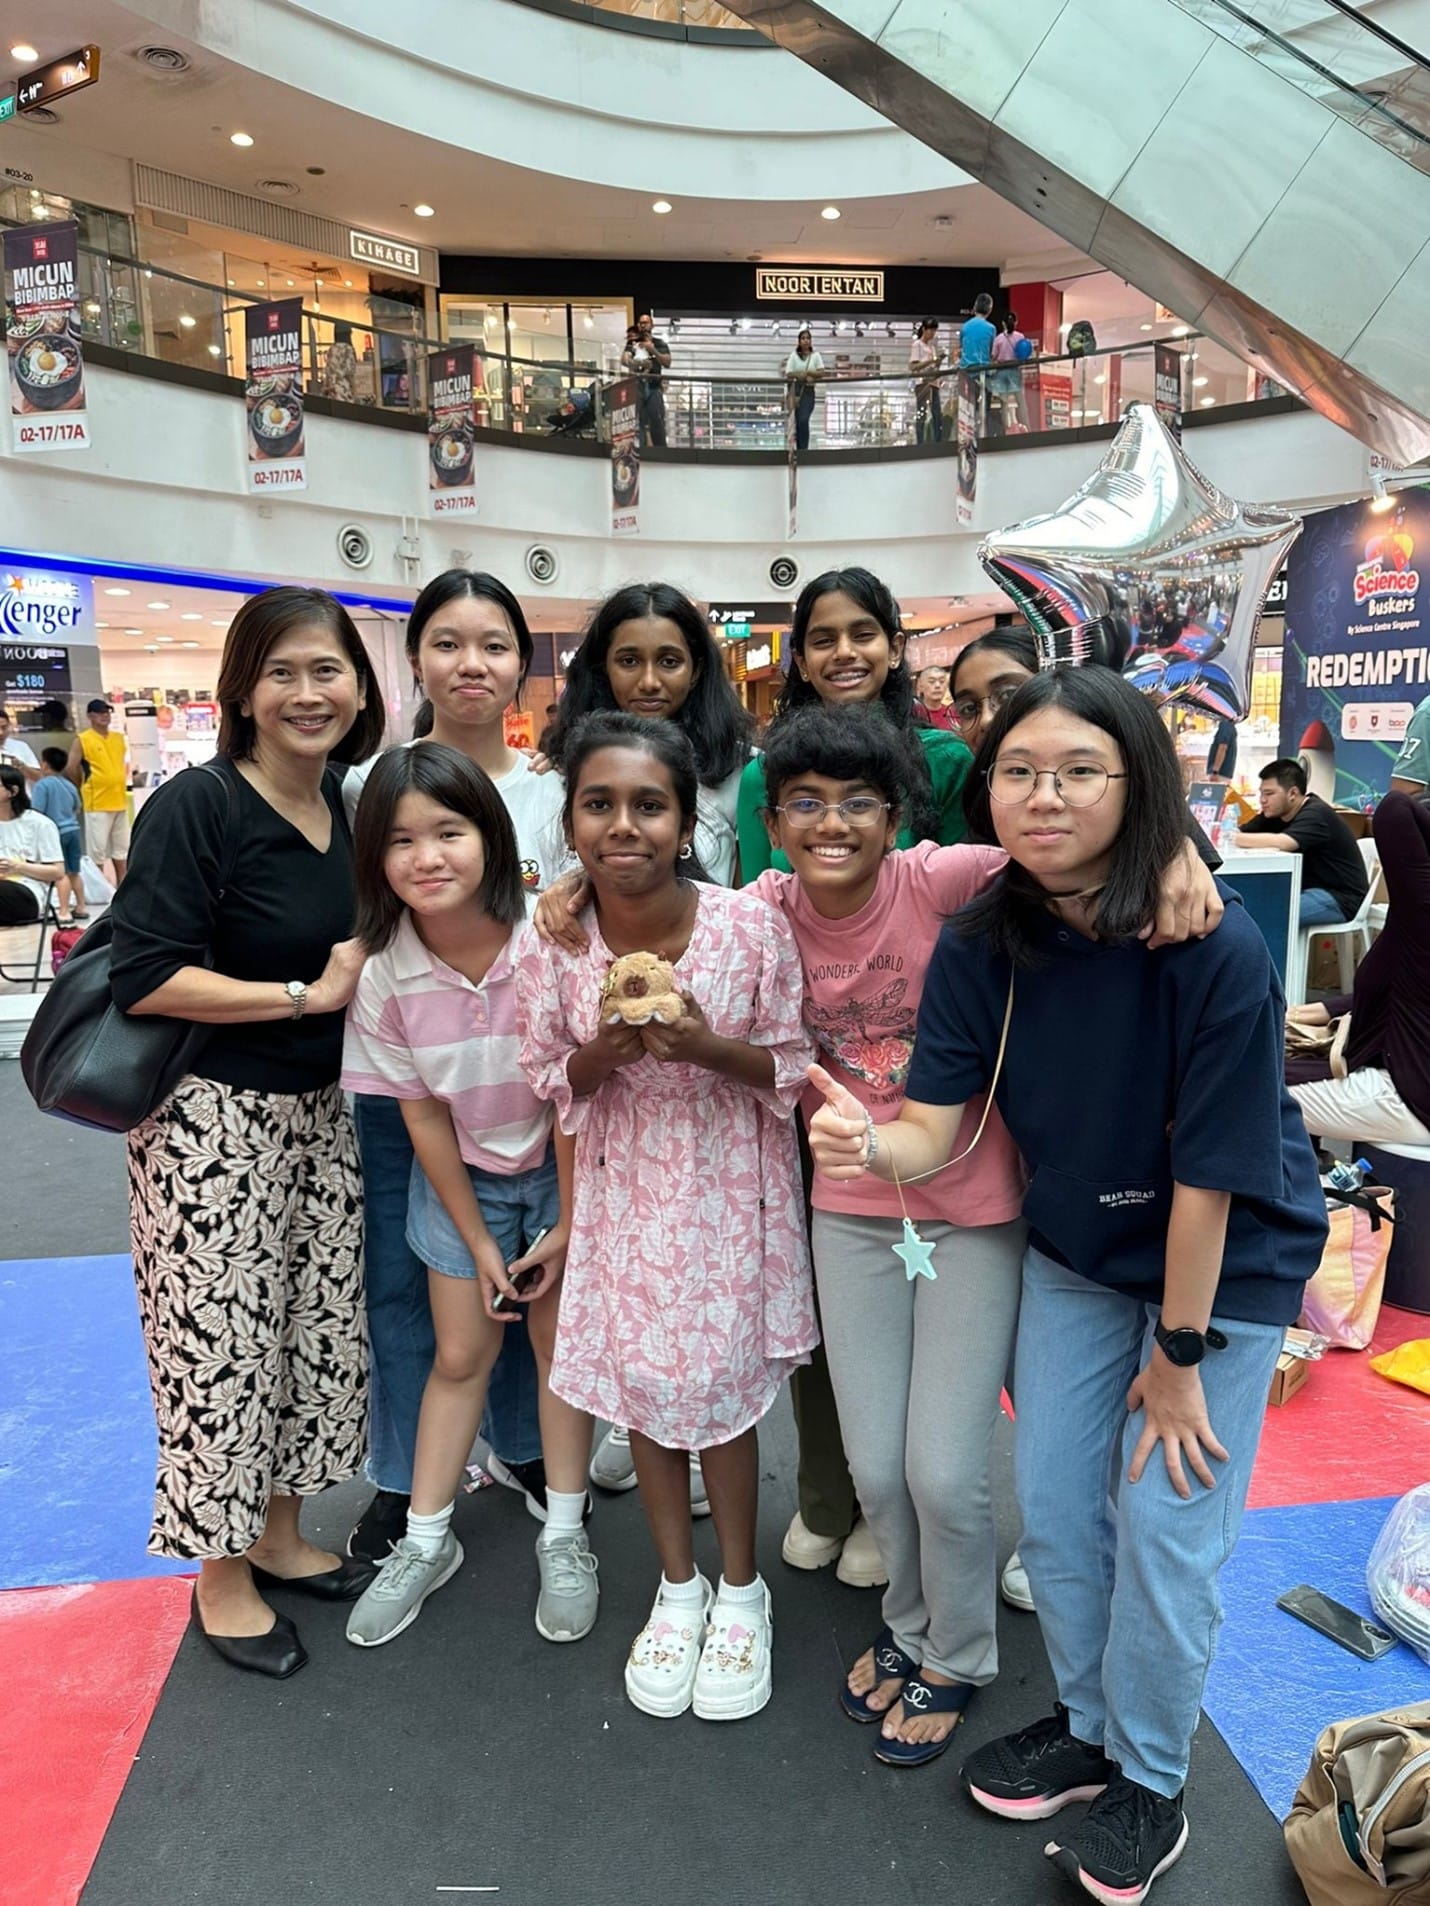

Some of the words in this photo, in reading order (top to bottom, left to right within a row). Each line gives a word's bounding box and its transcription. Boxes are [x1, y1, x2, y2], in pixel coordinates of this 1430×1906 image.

[13, 261, 74, 290] MICUN
[765, 276, 811, 292] NOOR
[821, 277, 875, 294] ENTAN
[14, 283, 75, 306] BIBIMBAP
[251, 331, 299, 356] MICUN
[433, 374, 471, 398] MICUN
[20, 424, 85, 442] 02-17/17A
[254, 468, 303, 484] 02-17/17A
[1355, 565, 1418, 601] Science
[1368, 597, 1415, 617] Buskers
[1355, 623, 1373, 634] Science
[1392, 619, 1420, 632] Singapore
[1306, 648, 1430, 688] REDEMPTI
[16, 674, 45, 688] $180
[867, 954, 904, 973] WORLD
